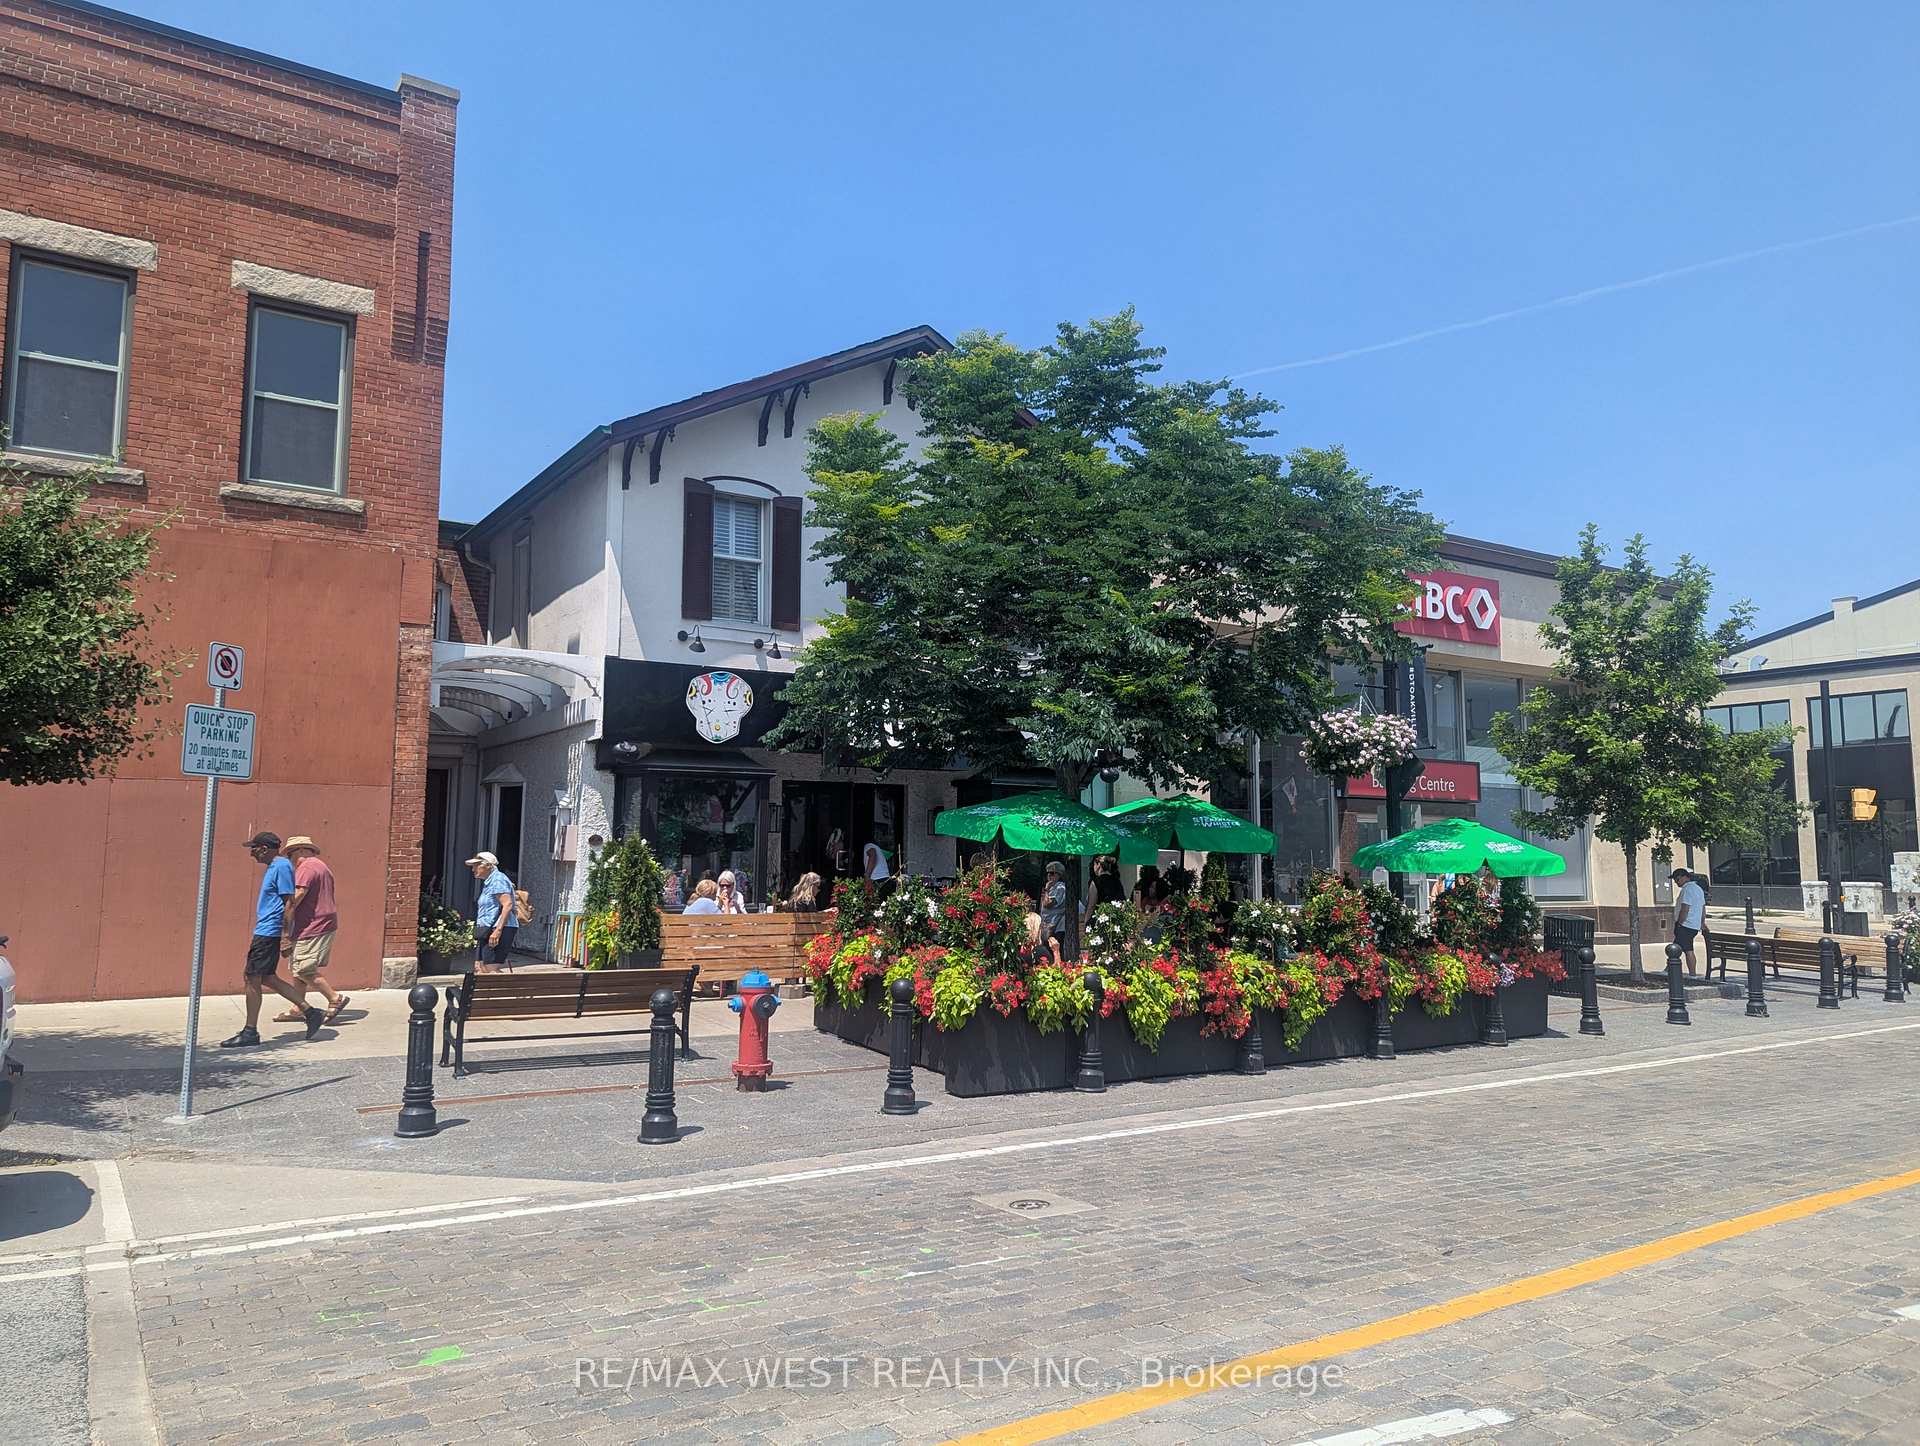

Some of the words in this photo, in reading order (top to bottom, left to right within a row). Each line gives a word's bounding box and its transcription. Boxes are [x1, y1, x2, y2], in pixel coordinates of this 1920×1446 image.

[1397, 579, 1465, 624] IBC
[194, 711, 221, 727] QUICK
[227, 716, 249, 730] STOP
[200, 727, 240, 743] PARKING
[188, 742, 198, 755] 20
[201, 744, 229, 758] minutes
[231, 749, 248, 760] max.
[196, 757, 205, 769] at
[207, 757, 217, 770] all
[219, 758, 239, 772] times
[1419, 775, 1455, 792] Centre
